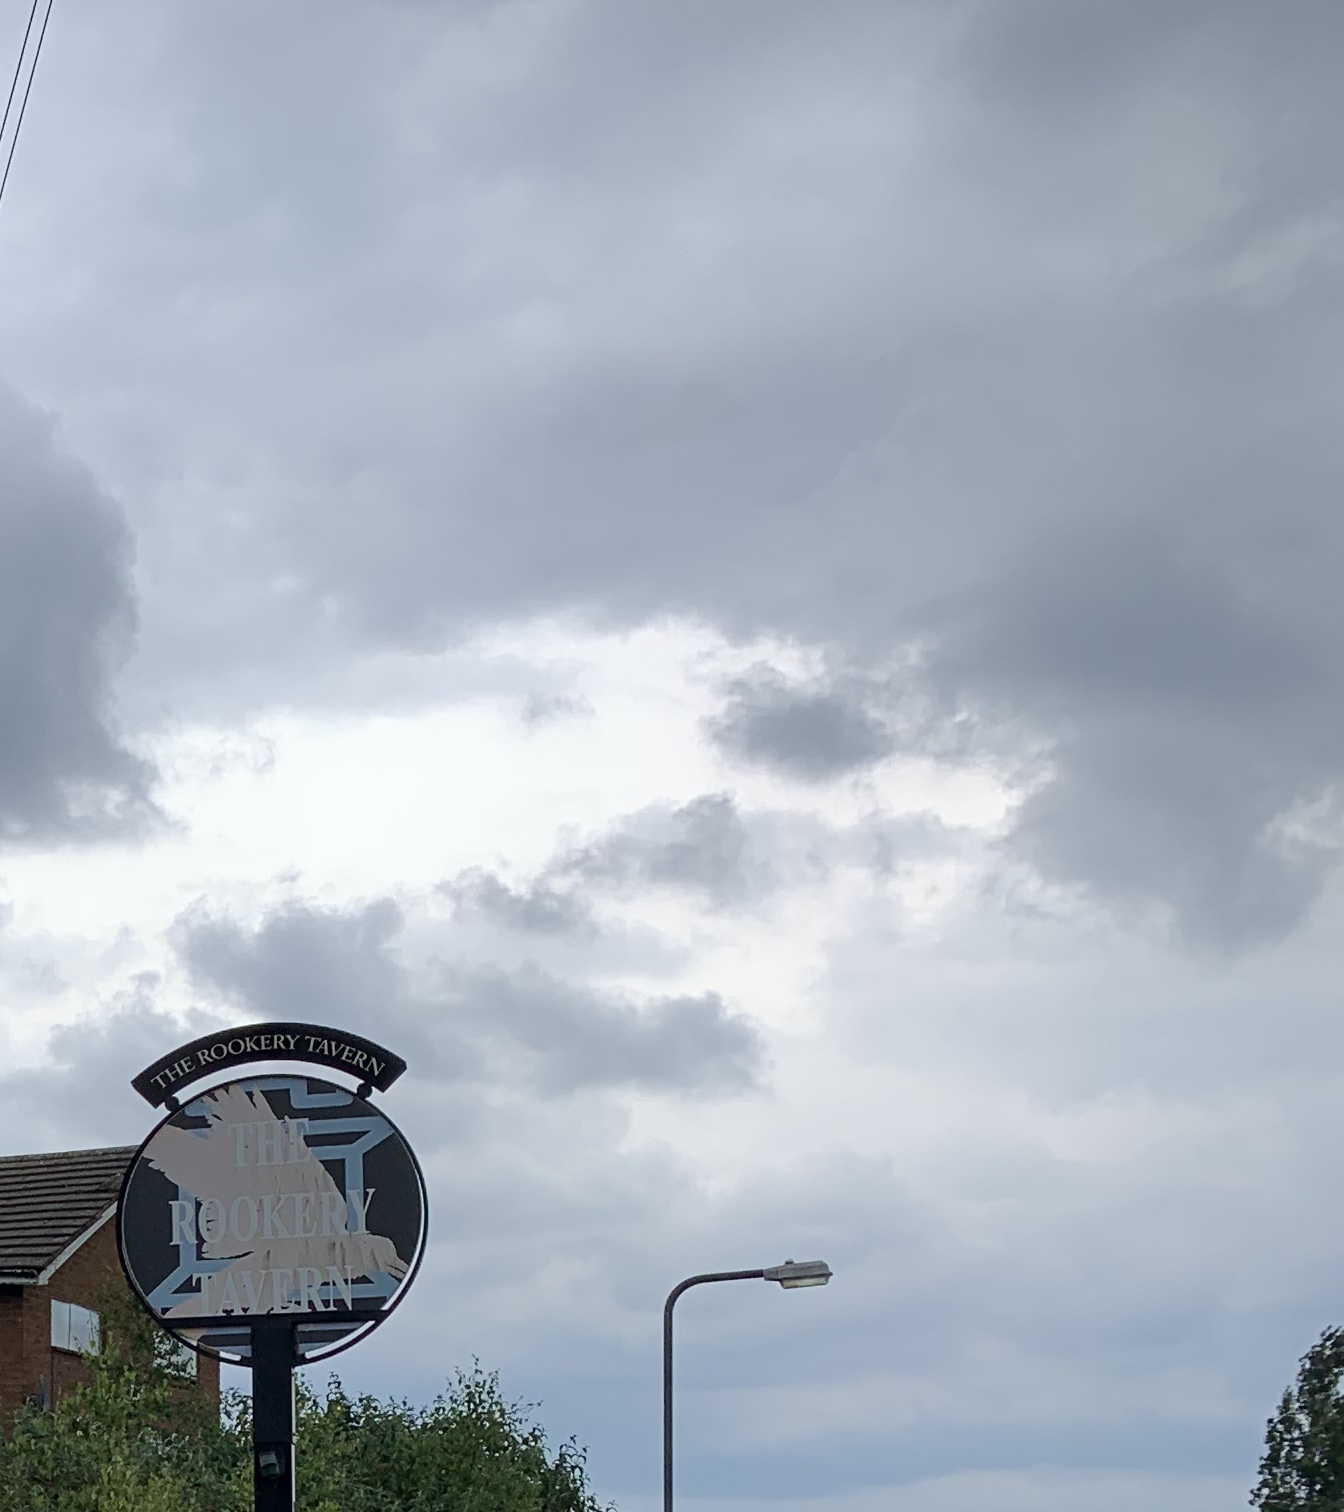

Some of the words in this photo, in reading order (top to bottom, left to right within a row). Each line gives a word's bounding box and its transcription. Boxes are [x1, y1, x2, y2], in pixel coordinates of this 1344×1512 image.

[150, 1056, 196, 1089] THE
[196, 1034, 300, 1066] ROOKERY
[304, 1035, 386, 1077] TAVERN
[228, 1116, 312, 1168] THE
[168, 1188, 376, 1246] ROOKERY
[192, 1264, 355, 1315] TAVERN
